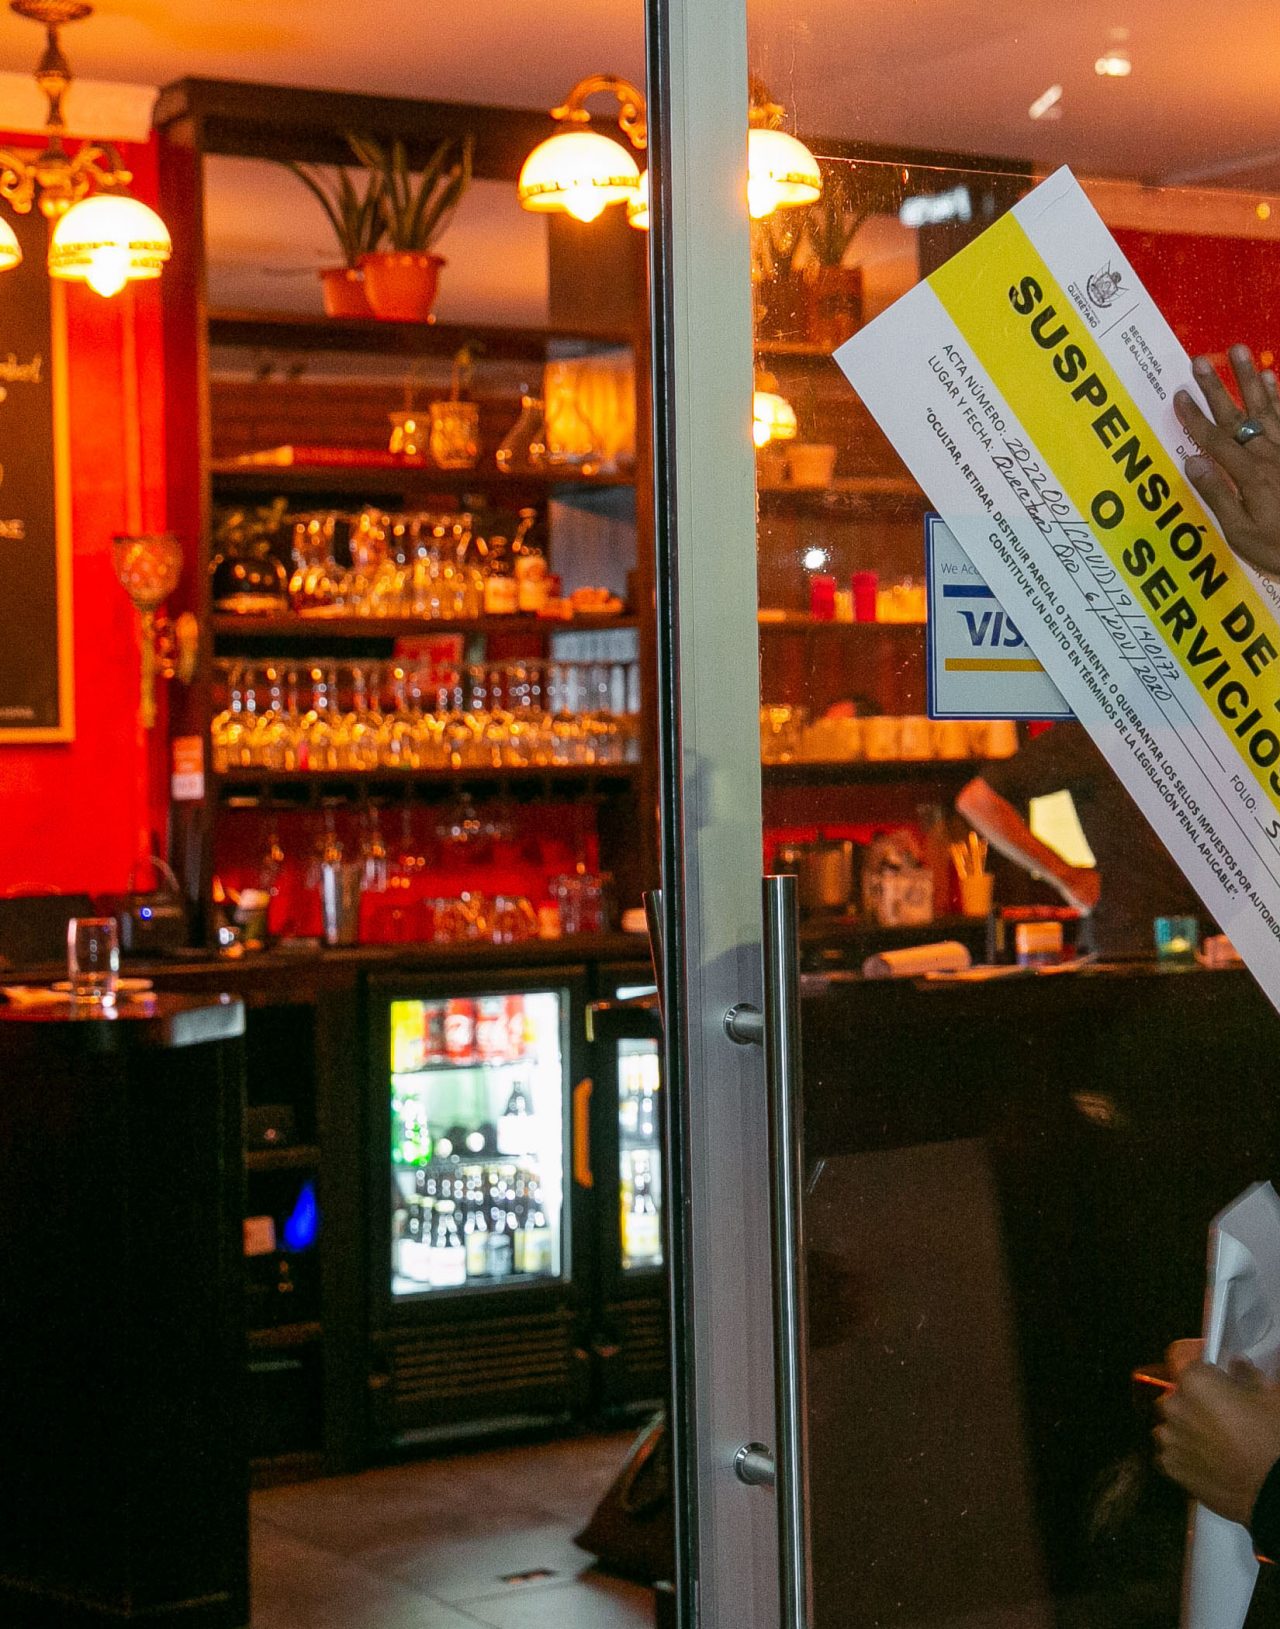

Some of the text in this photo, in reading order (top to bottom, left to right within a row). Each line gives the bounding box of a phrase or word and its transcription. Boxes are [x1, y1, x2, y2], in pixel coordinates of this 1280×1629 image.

[1068, 282, 1099, 328] QUERÉTARO
[1121, 332, 1166, 400] DE SALUD-SESEQ
[1129, 326, 1162, 375] SECRETARÍA
[928, 356, 959, 398] LUGAR
[957, 397, 967, 406] Y
[963, 408, 993, 452] FECHA:
[1009, 277, 1229, 600] SUSPENSIÓN
[1221, 602, 1278, 677] DE
[1091, 490, 1124, 529] O
[941, 563, 957, 575] We
[943, 345, 967, 377] ACTA
[965, 376, 1006, 436] NÚMERO:
[1231, 775, 1256, 813] FOLIO:
[957, 610, 1032, 646] VIS
[961, 464, 993, 512] RETIRAR,
[993, 512, 1029, 563] DESTRUIR
[1027, 562, 1057, 606] PARCIAL
[1056, 605, 1065, 615] O
[1063, 614, 1110, 685] TOTALMENTE,
[1109, 684, 1118, 694] O
[1116, 694, 1163, 762] QUEBRANTAR
[1161, 760, 1177, 781] LOS
[1174, 780, 1200, 815] SELLOS
[1197, 814, 1237, 870] IMPUESTOS
[1234, 870, 1251, 892] POR
[989, 533, 1034, 597] CONSTITUYE
[1032, 596, 1046, 614] UN
[1043, 614, 1070, 650] DELITO
[1068, 650, 1081, 666] EN
[1079, 665, 1117, 719] TÉRMINOS
[1114, 719, 1128, 735] DE
[1125, 734, 1136, 749] LA
[1134, 748, 1179, 811] LEGISLACIÓN
[1176, 810, 1199, 843] PENAL
